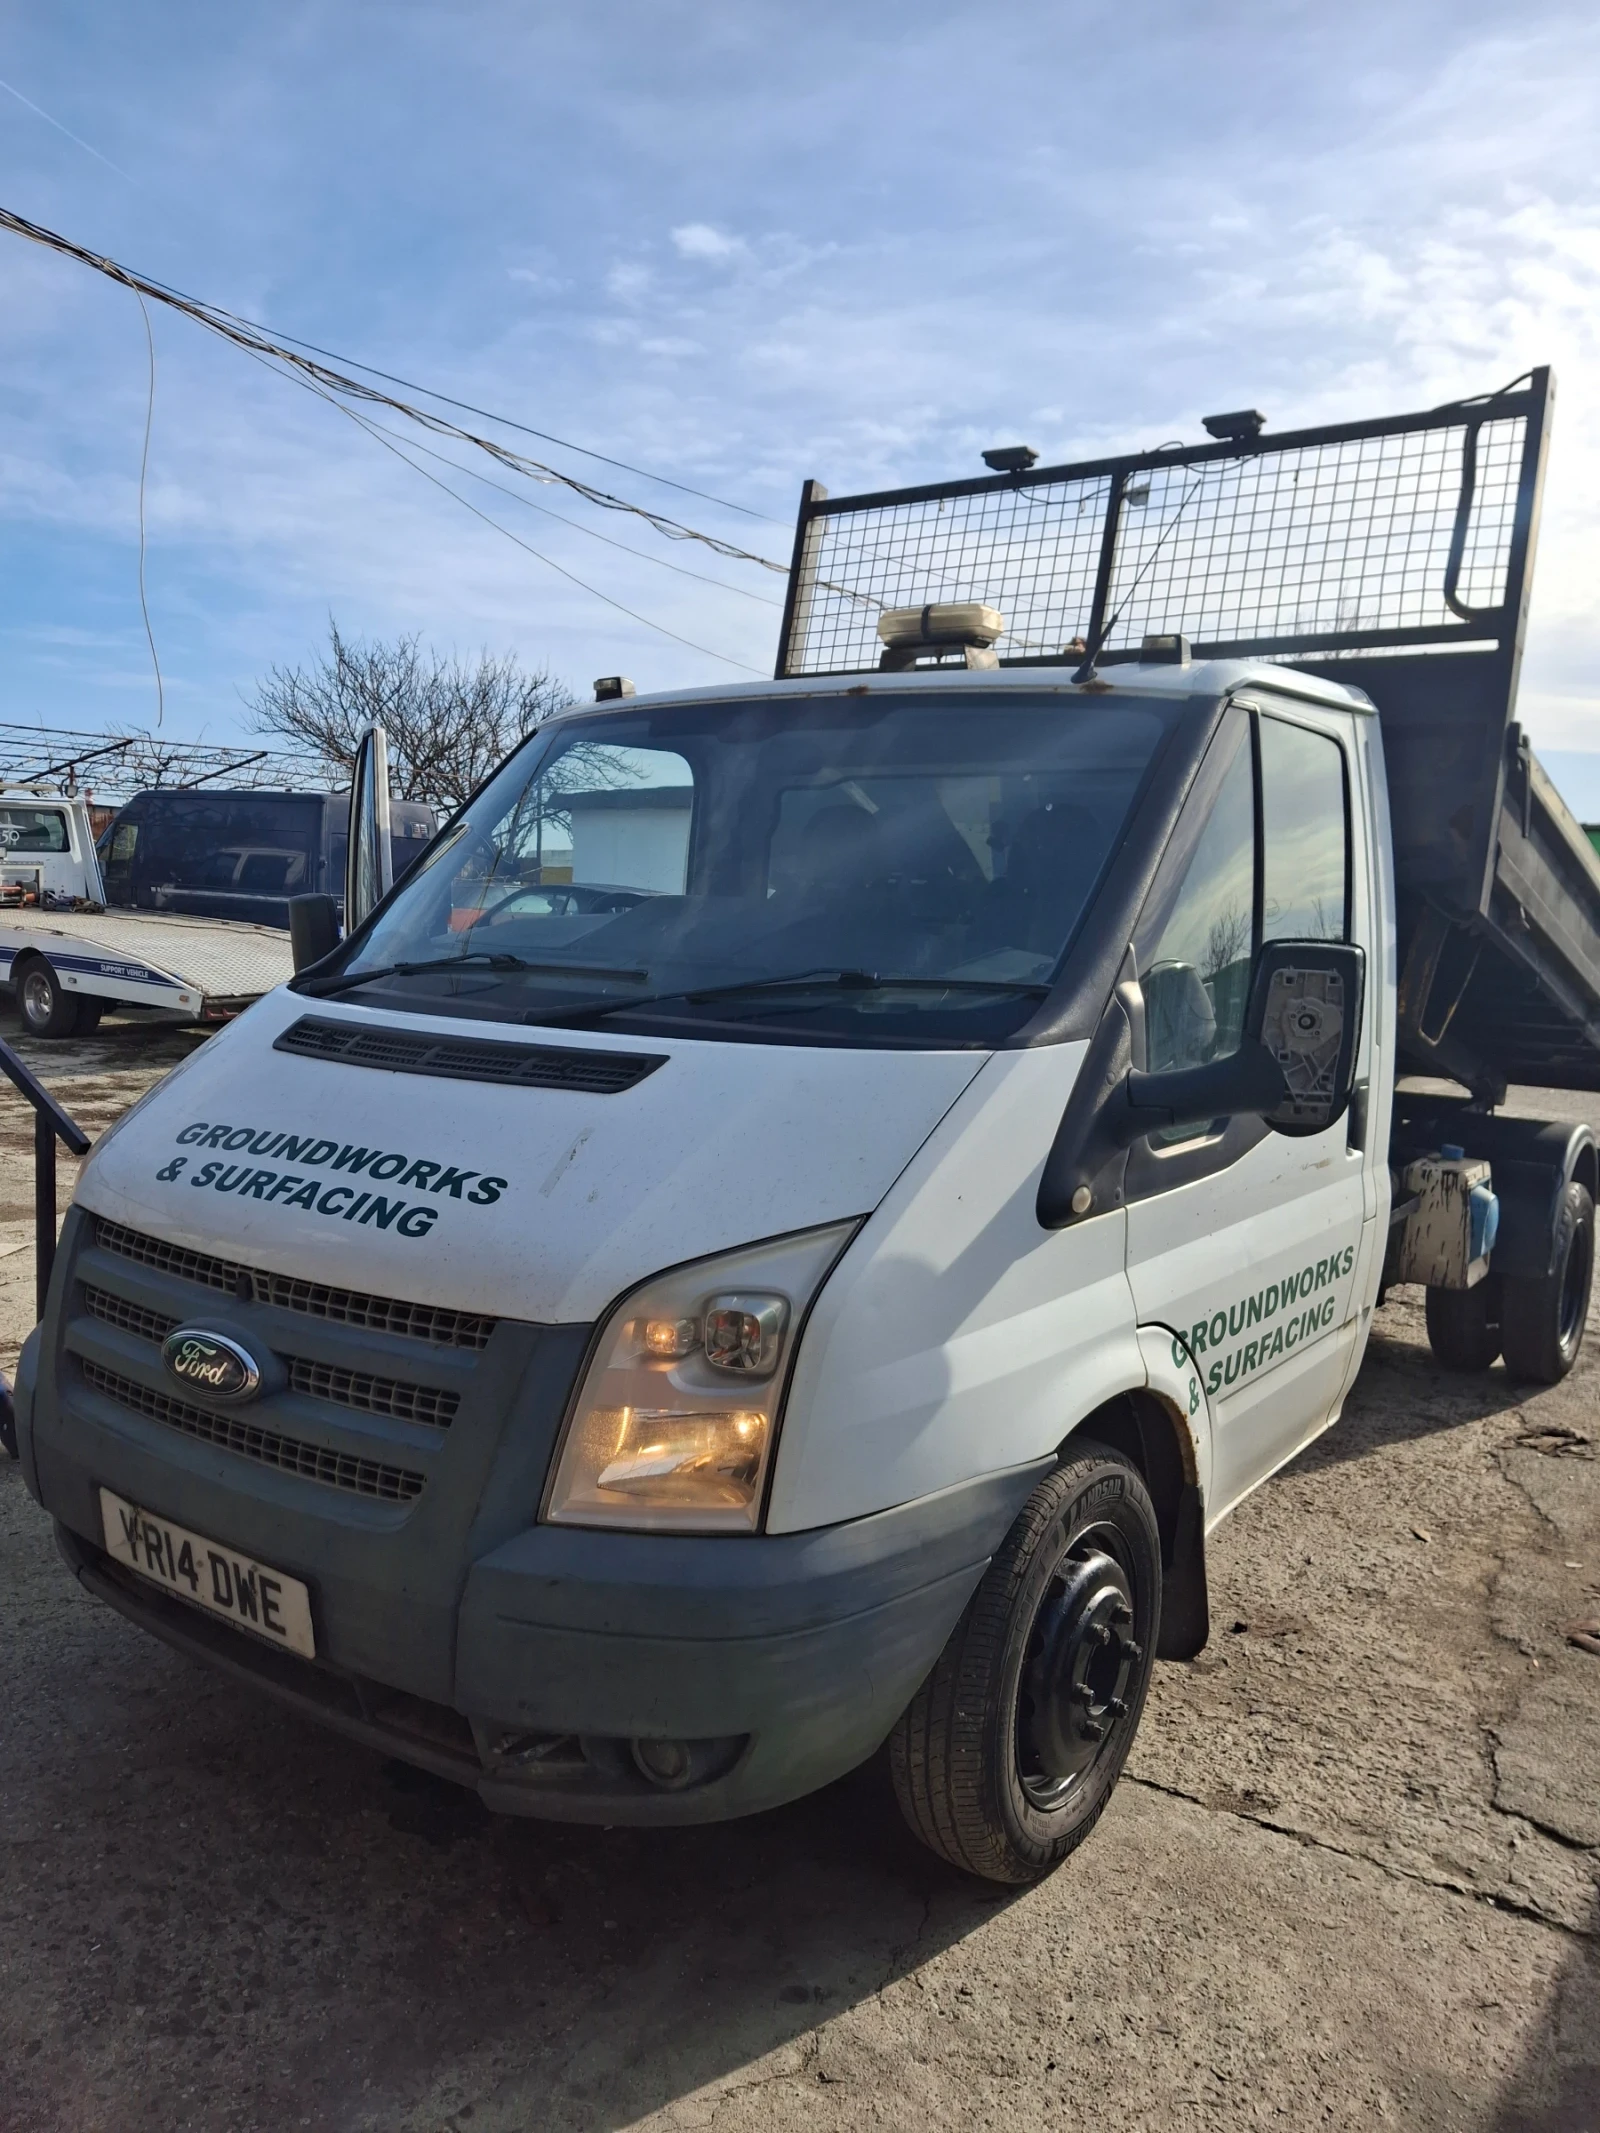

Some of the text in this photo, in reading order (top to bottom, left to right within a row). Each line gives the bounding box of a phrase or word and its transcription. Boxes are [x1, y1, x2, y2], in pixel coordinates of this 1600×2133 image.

[100, 963, 149, 979] SUPPORT VEHICLE
[155, 1156, 439, 1238] & SURFACING
[175, 1122, 509, 1206] GROUNDWORKS
[1171, 1245, 1355, 1370] GROUNDWORKS
[174, 1339, 229, 1386] Ford
[1188, 1295, 1336, 1416] & SURFACING
[118, 1507, 200, 1592] YR14
[206, 1548, 287, 1636] DWE
